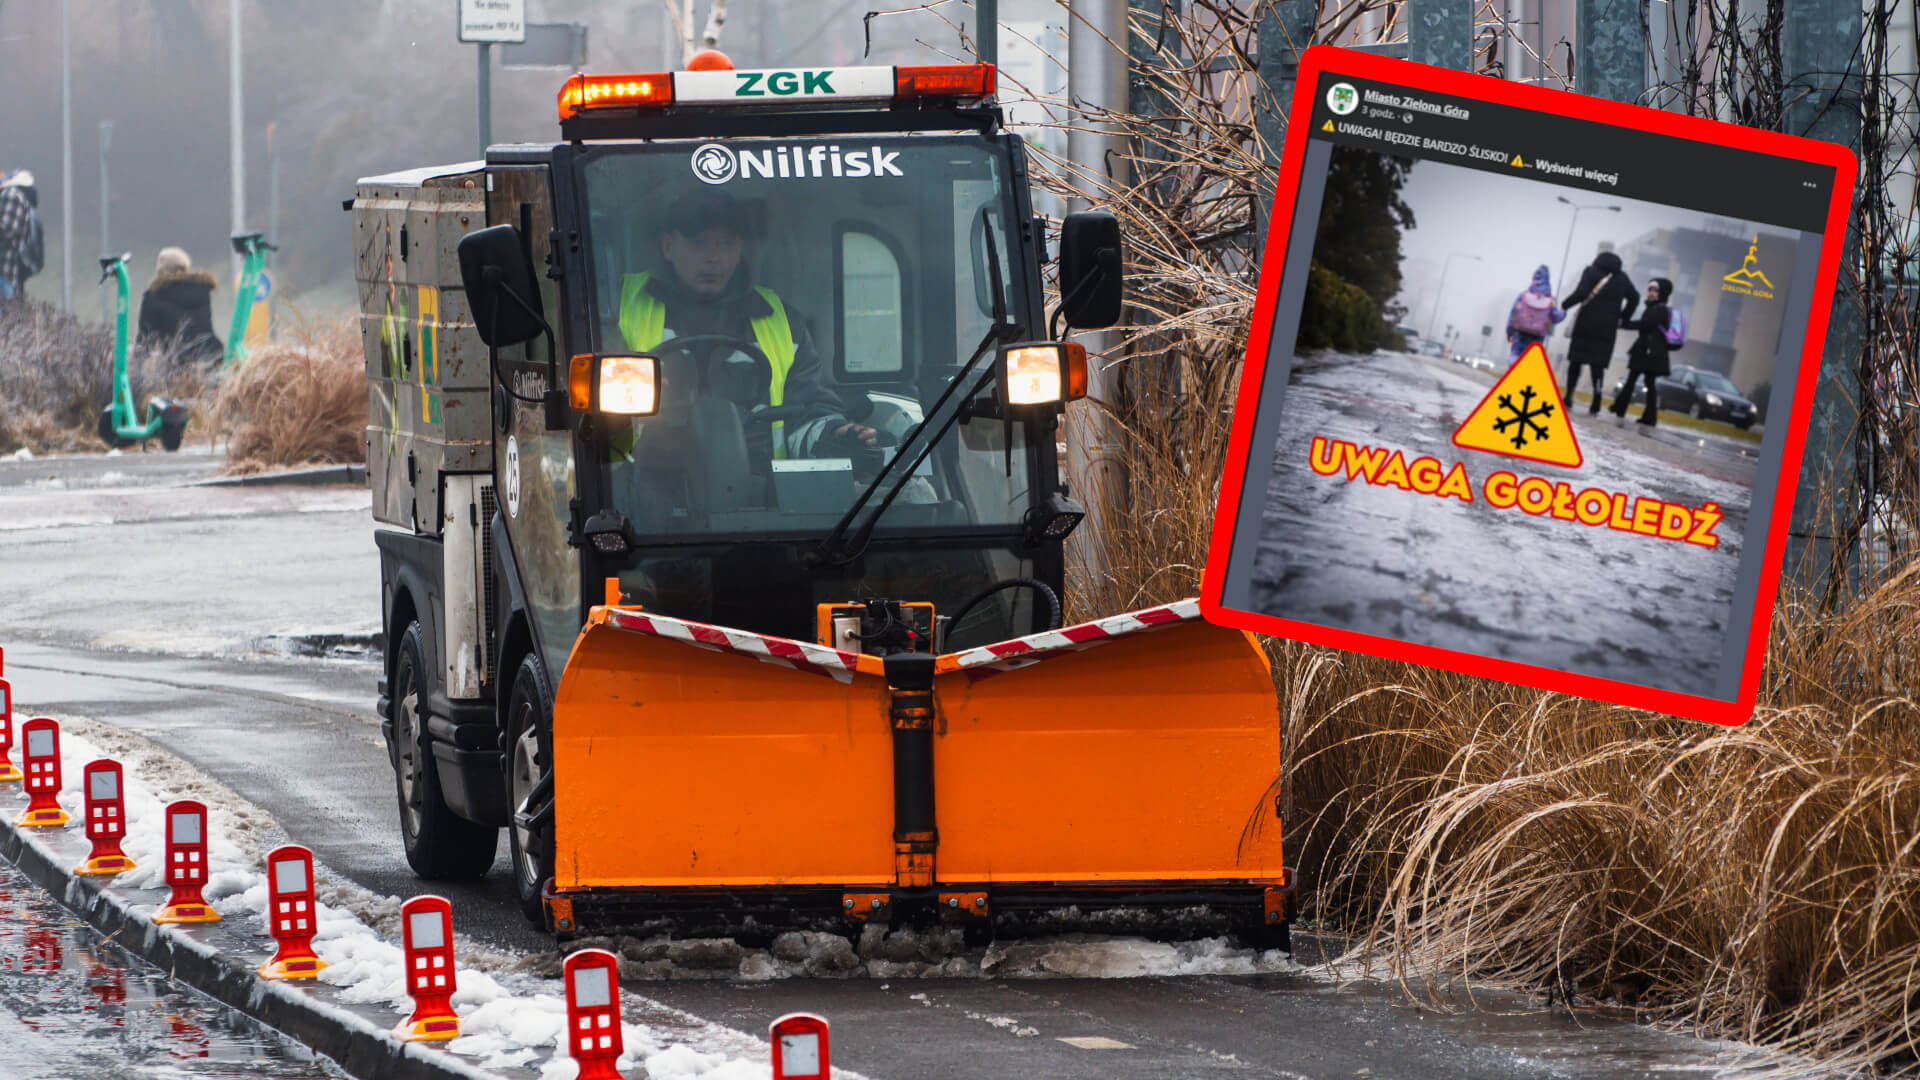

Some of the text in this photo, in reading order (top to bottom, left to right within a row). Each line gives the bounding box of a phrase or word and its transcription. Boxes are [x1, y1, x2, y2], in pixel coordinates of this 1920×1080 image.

[736, 70, 836, 96] ZGK
[739, 145, 904, 179] Nilfisk
[508, 451, 518, 502] 25
